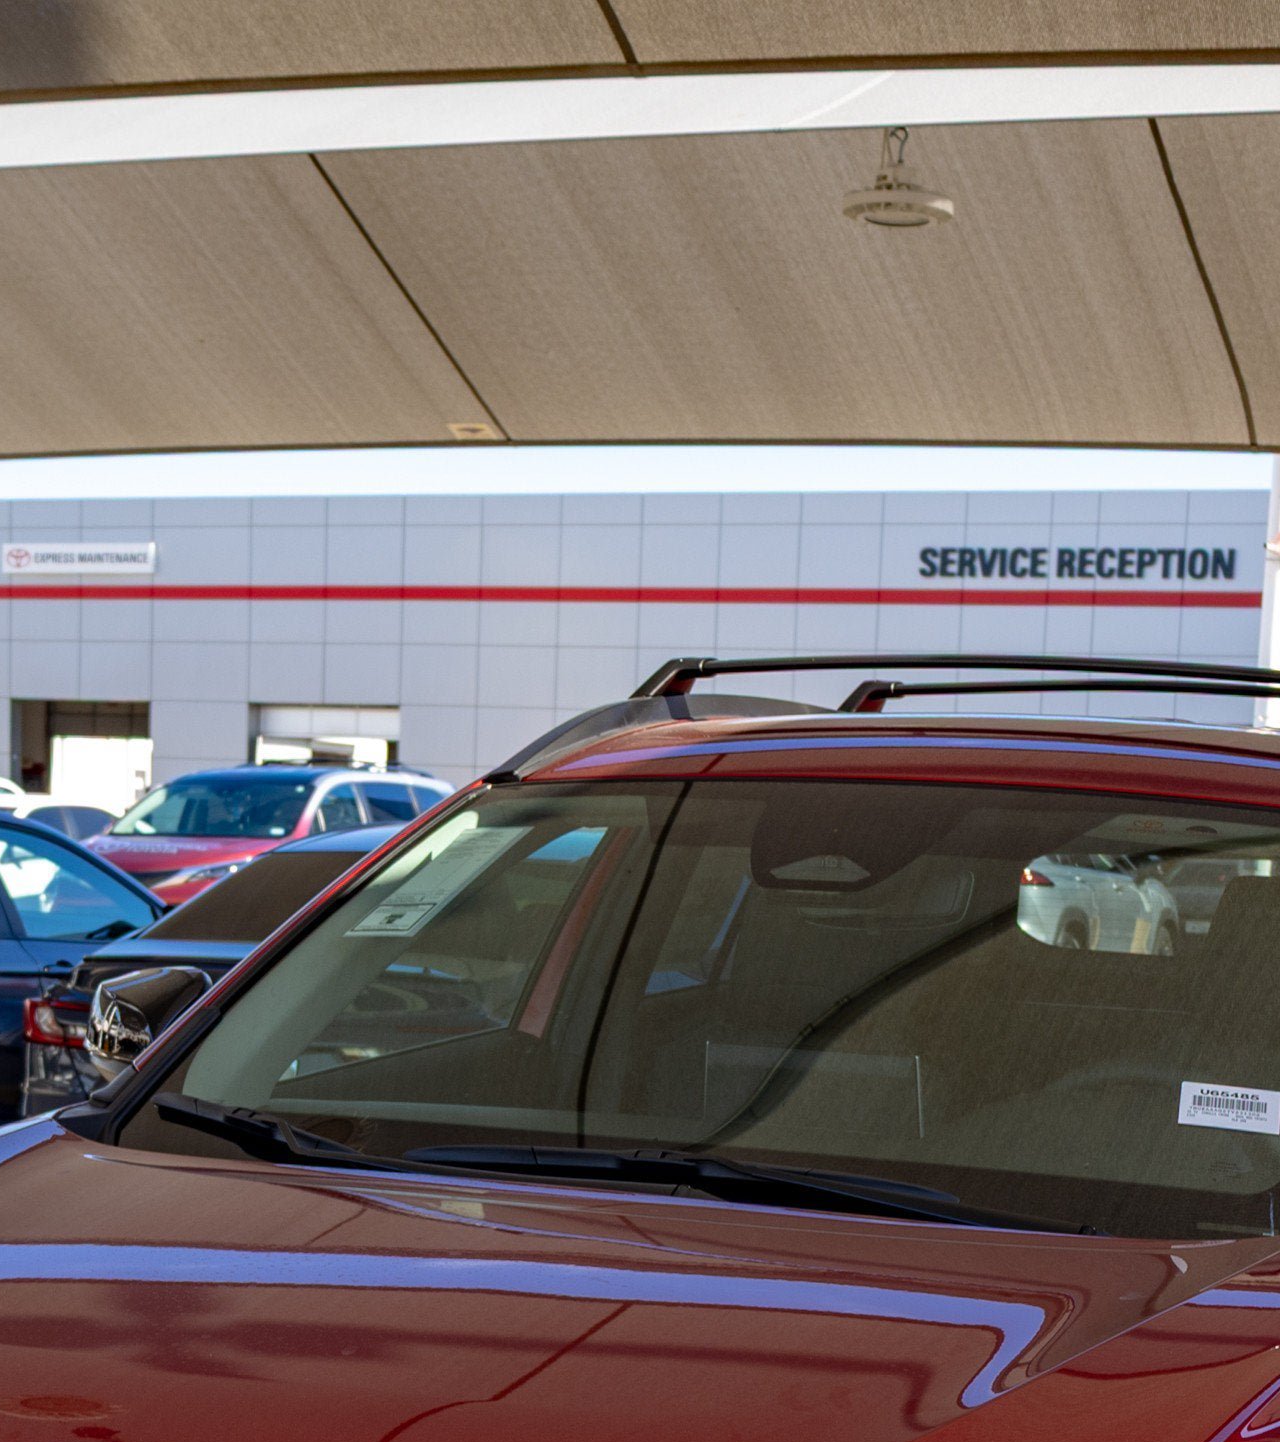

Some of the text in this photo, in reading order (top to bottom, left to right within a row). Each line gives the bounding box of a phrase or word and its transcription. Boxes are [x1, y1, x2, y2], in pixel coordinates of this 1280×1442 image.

[33, 552, 148, 564] EXPRESS MAINTENANCE
[919, 547, 1236, 580] SERVICE RECEPTION
